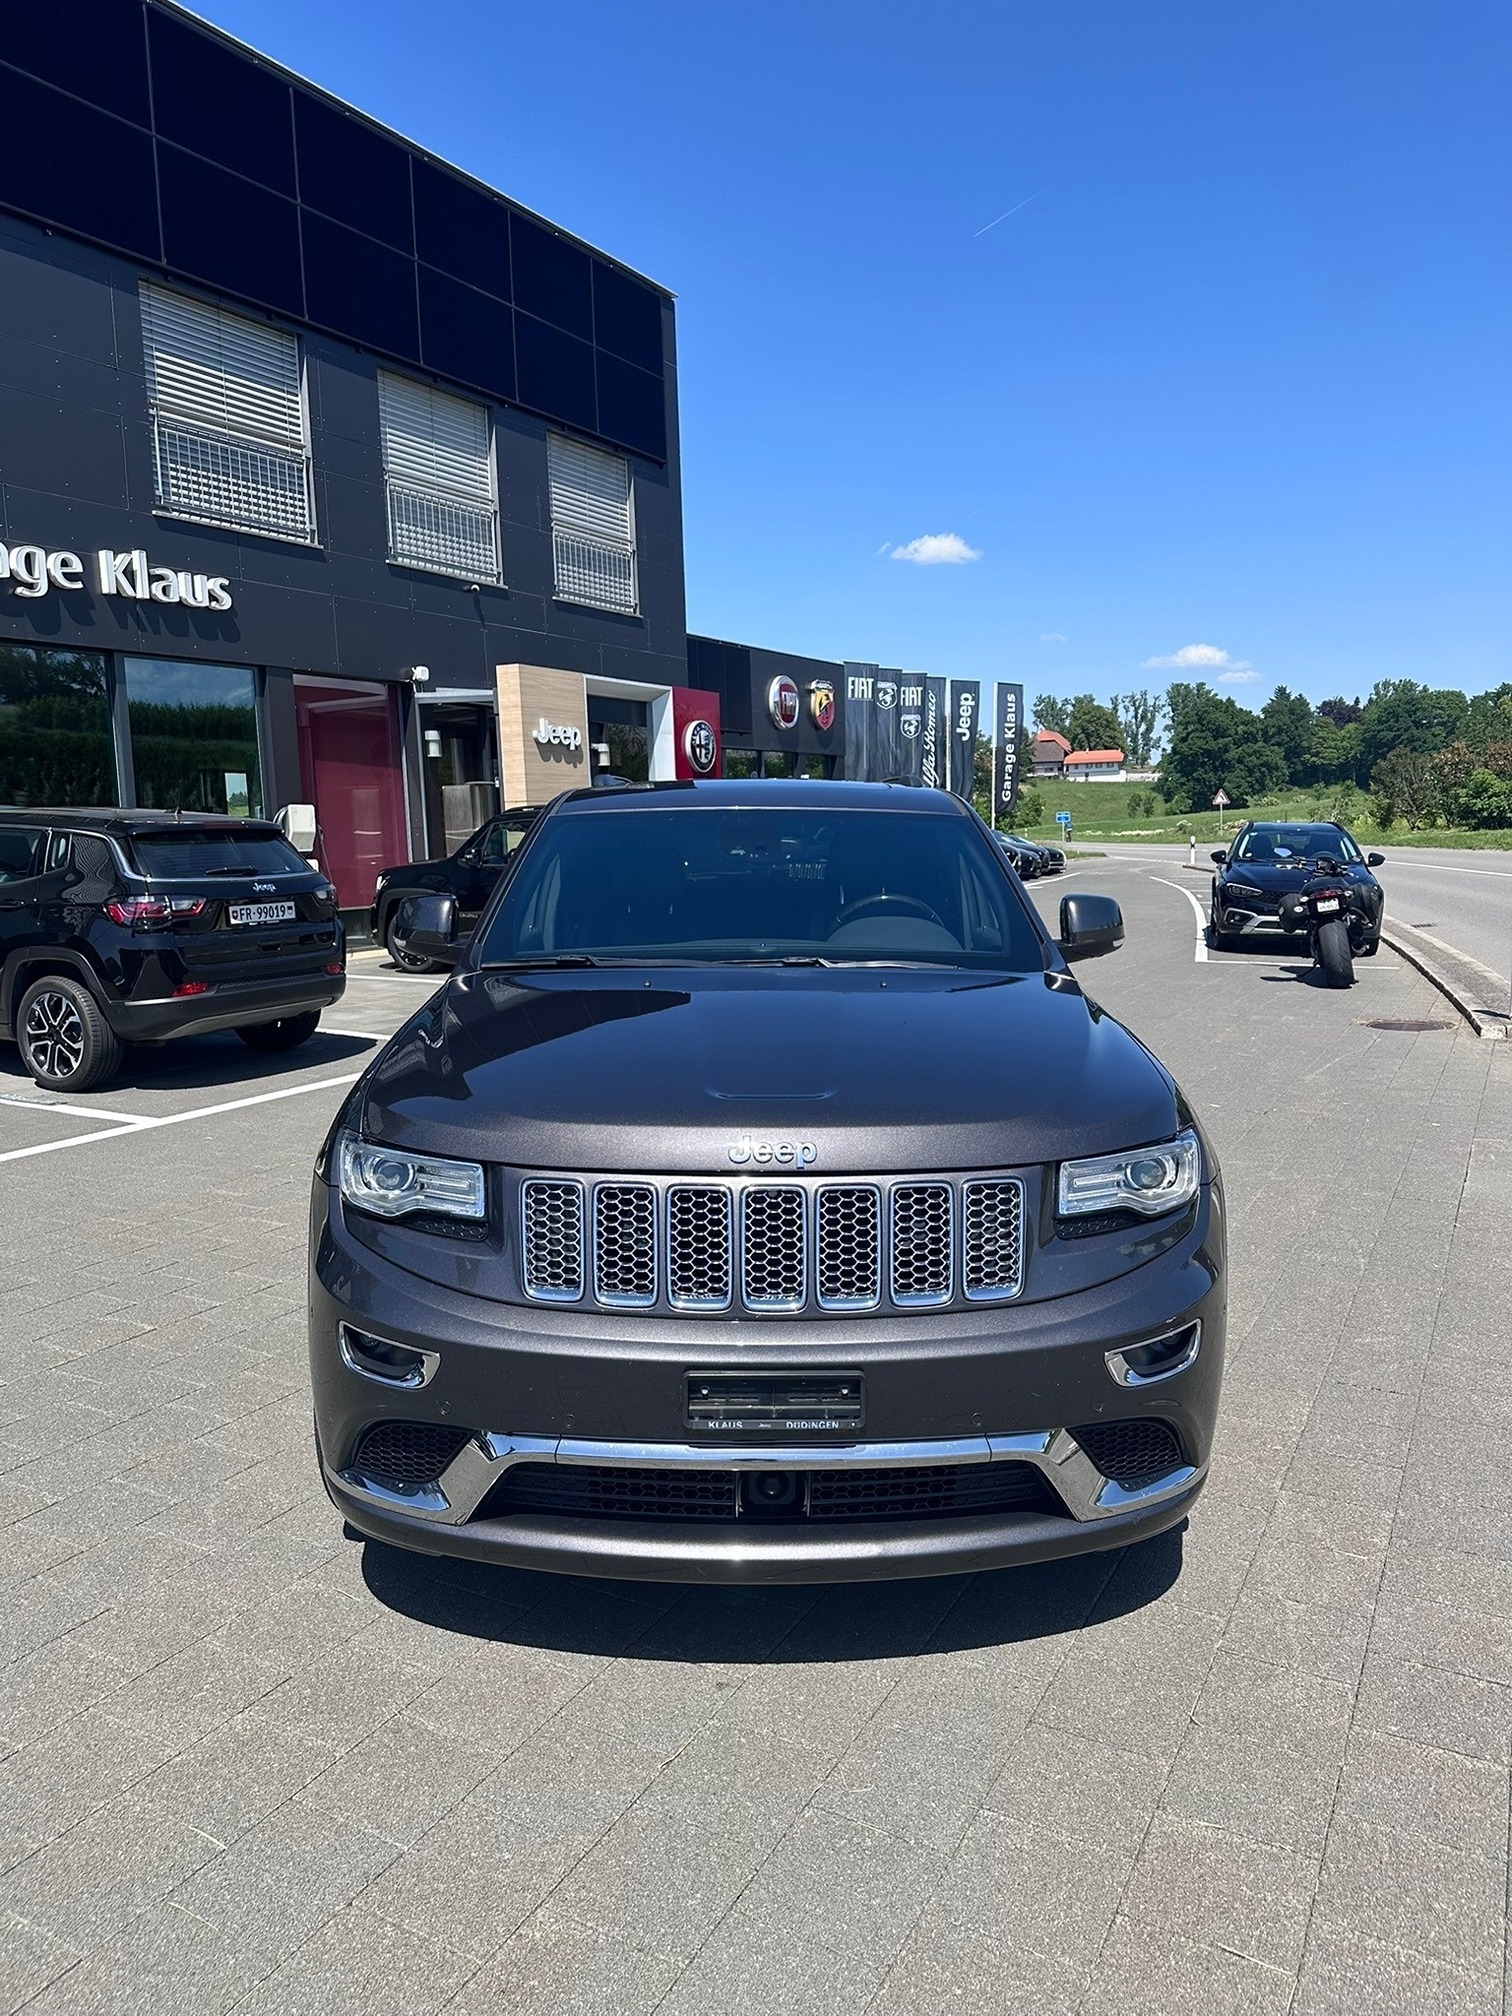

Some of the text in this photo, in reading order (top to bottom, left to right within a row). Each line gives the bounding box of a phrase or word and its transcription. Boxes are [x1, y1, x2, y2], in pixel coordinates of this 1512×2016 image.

[99, 549, 233, 611] Klaus
[781, 691, 797, 716] FIAT
[848, 676, 874, 699] FIAT
[900, 686, 923, 706] FIAT
[532, 717, 582, 750] Jeep
[923, 690, 937, 753] Romeo
[956, 692, 976, 742] Jeep
[1001, 693, 1017, 802] Garage Klaus
[252, 882, 277, 893] Jeep
[728, 1135, 818, 1169] Jeep
[708, 1420, 743, 1429] KLAUS
